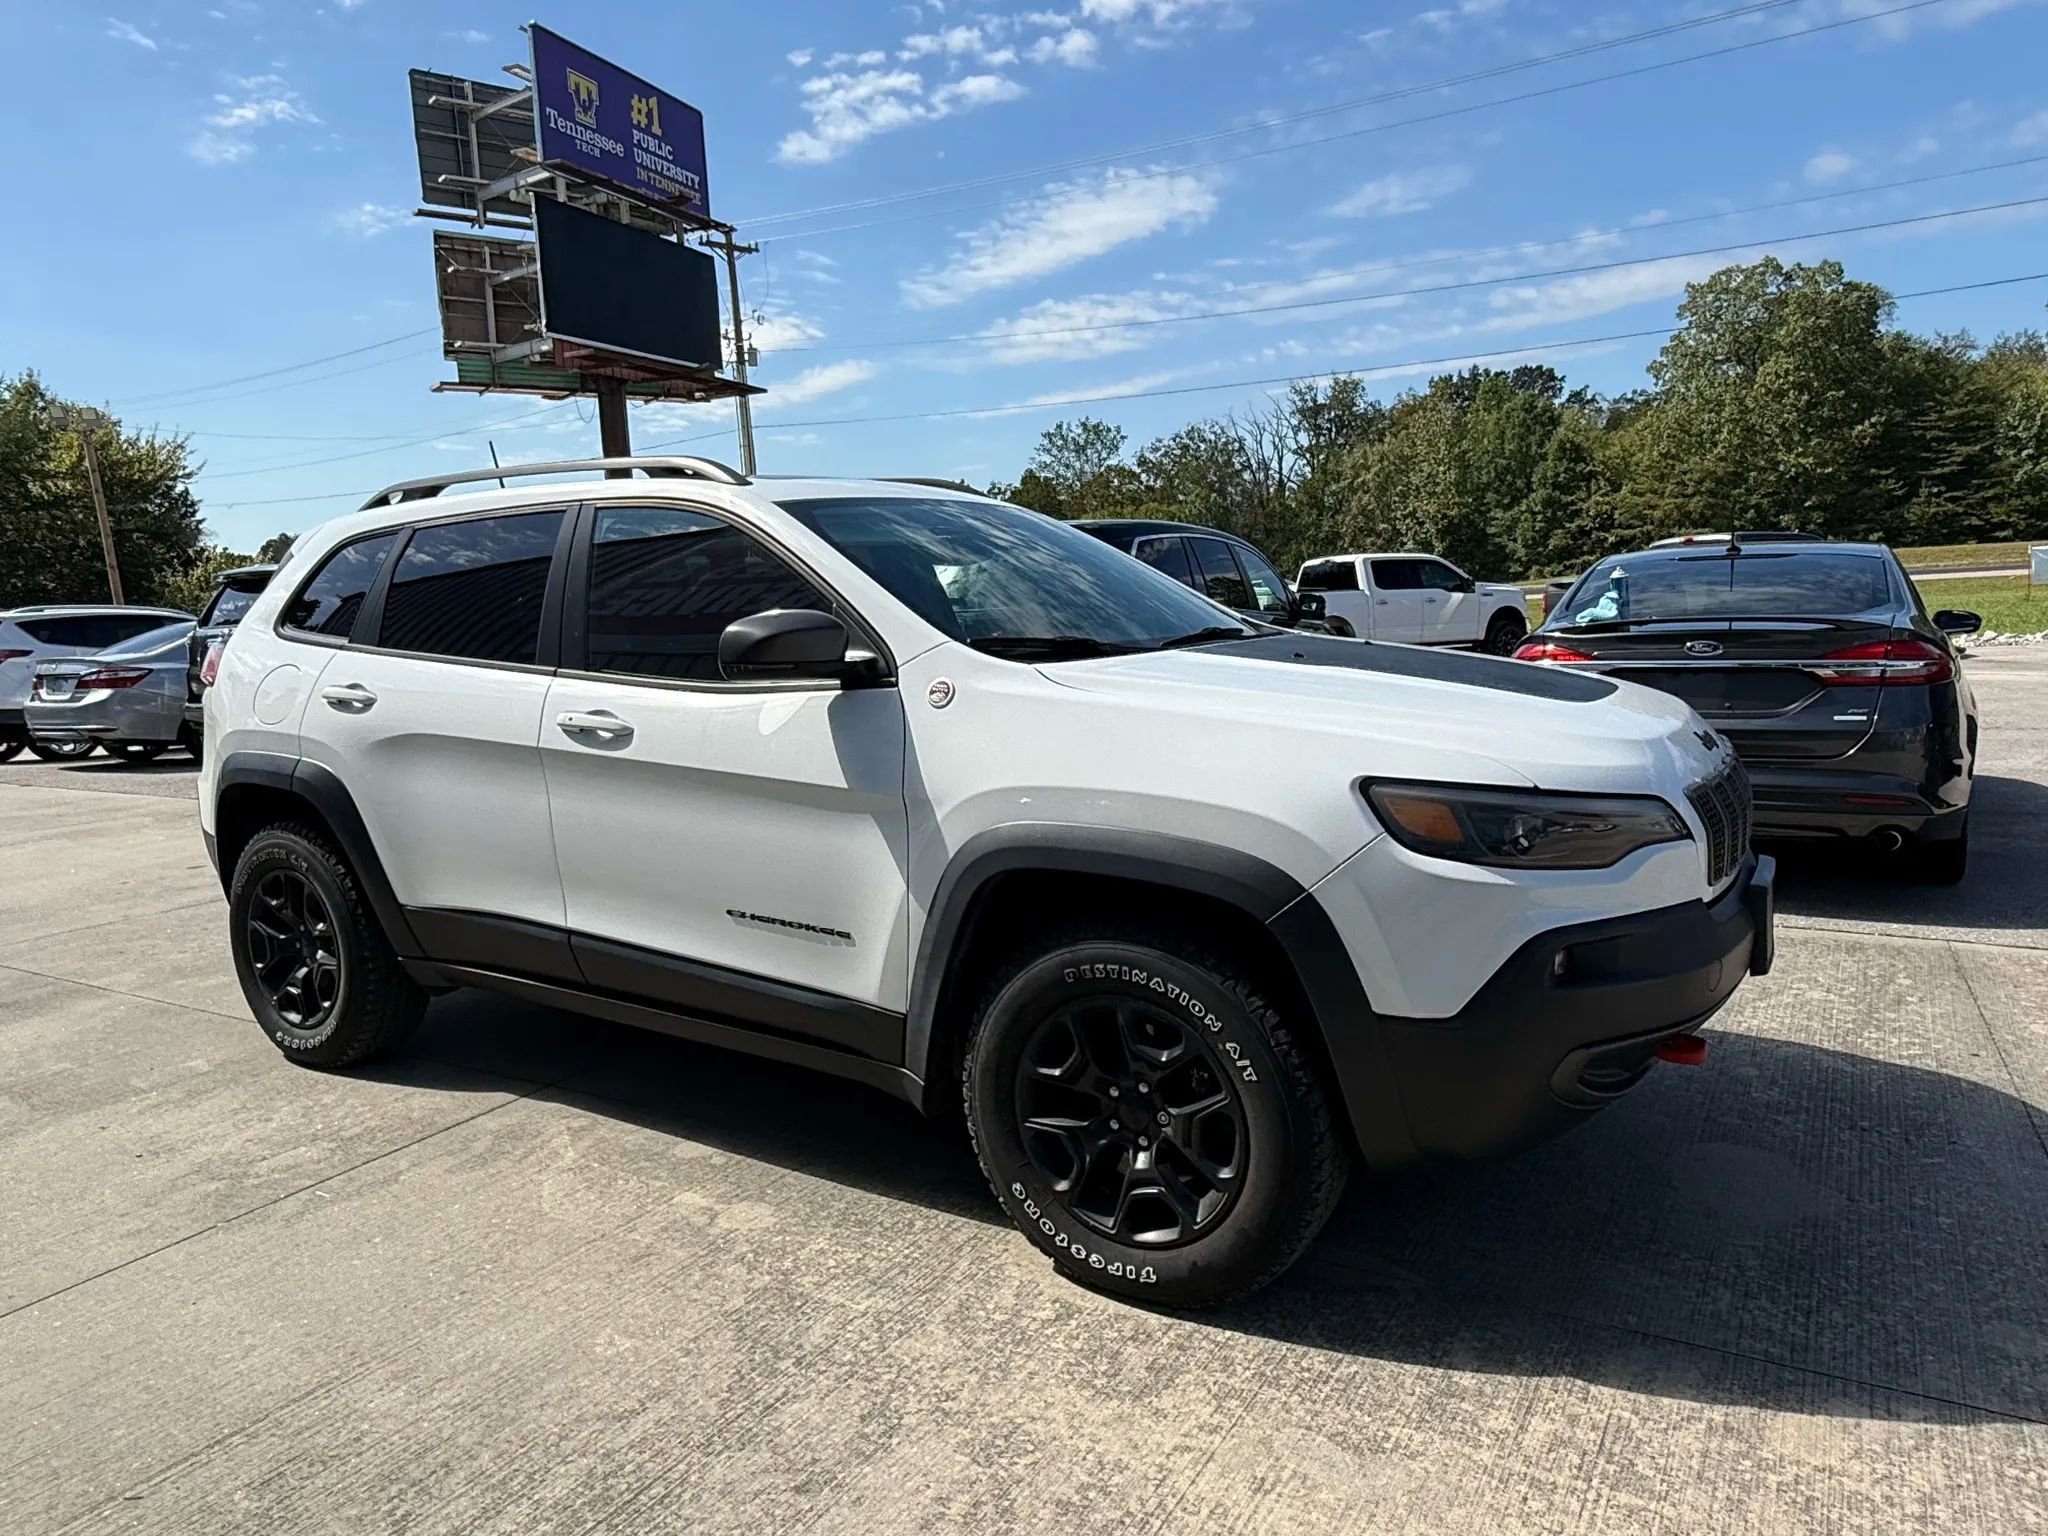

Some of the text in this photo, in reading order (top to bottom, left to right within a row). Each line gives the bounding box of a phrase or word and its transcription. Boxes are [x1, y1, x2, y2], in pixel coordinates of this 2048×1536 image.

[546, 107, 625, 157] Tennessee
[631, 93, 662, 137] #1
[575, 139, 601, 158] TECH
[632, 128, 674, 160] PUBLIC
[633, 147, 700, 189] UNIVERSITY
[636, 166, 648, 183] IN
[726, 909, 852, 940] CHEROKEE
[1064, 964, 1258, 1082] DESTINATION A/T
